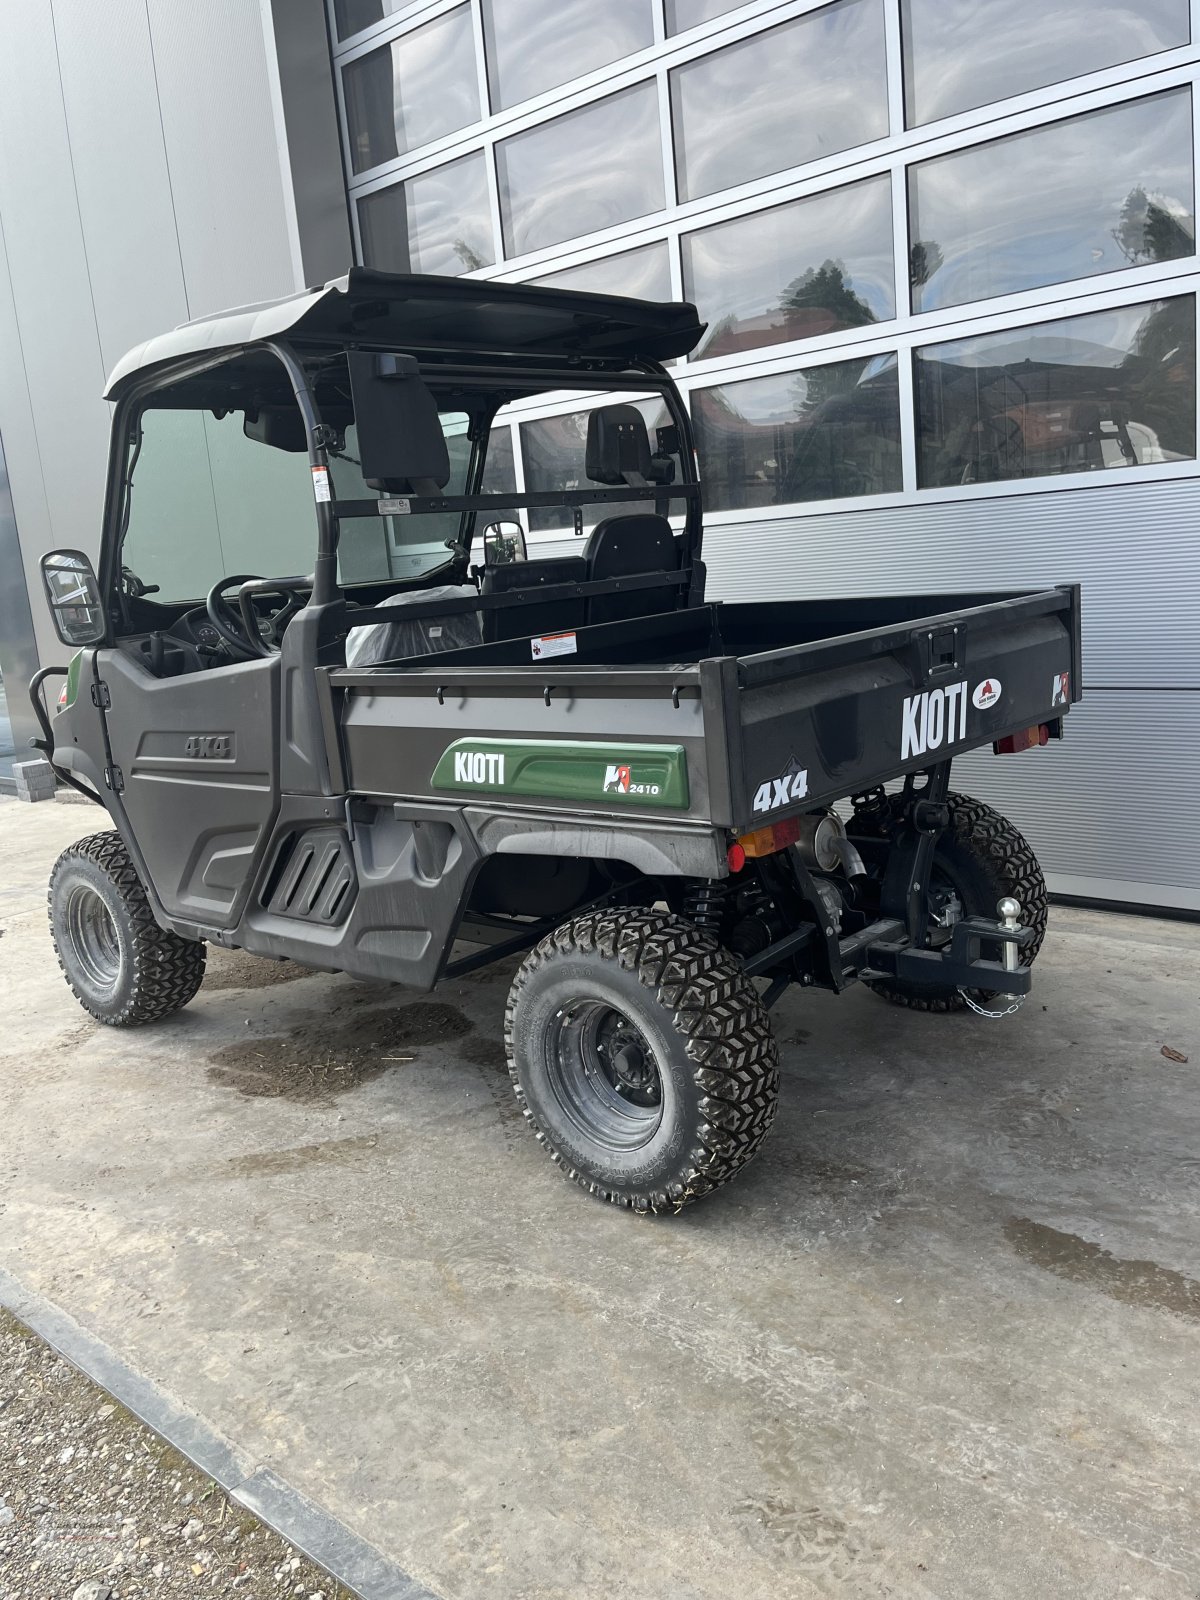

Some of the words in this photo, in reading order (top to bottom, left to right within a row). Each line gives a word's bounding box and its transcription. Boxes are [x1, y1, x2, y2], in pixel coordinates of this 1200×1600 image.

[900, 680, 968, 761] KIOTI
[185, 736, 231, 758] 4X4
[455, 751, 505, 785] KIOTI
[629, 786, 660, 795] 2410
[752, 769, 809, 813] 4X4
